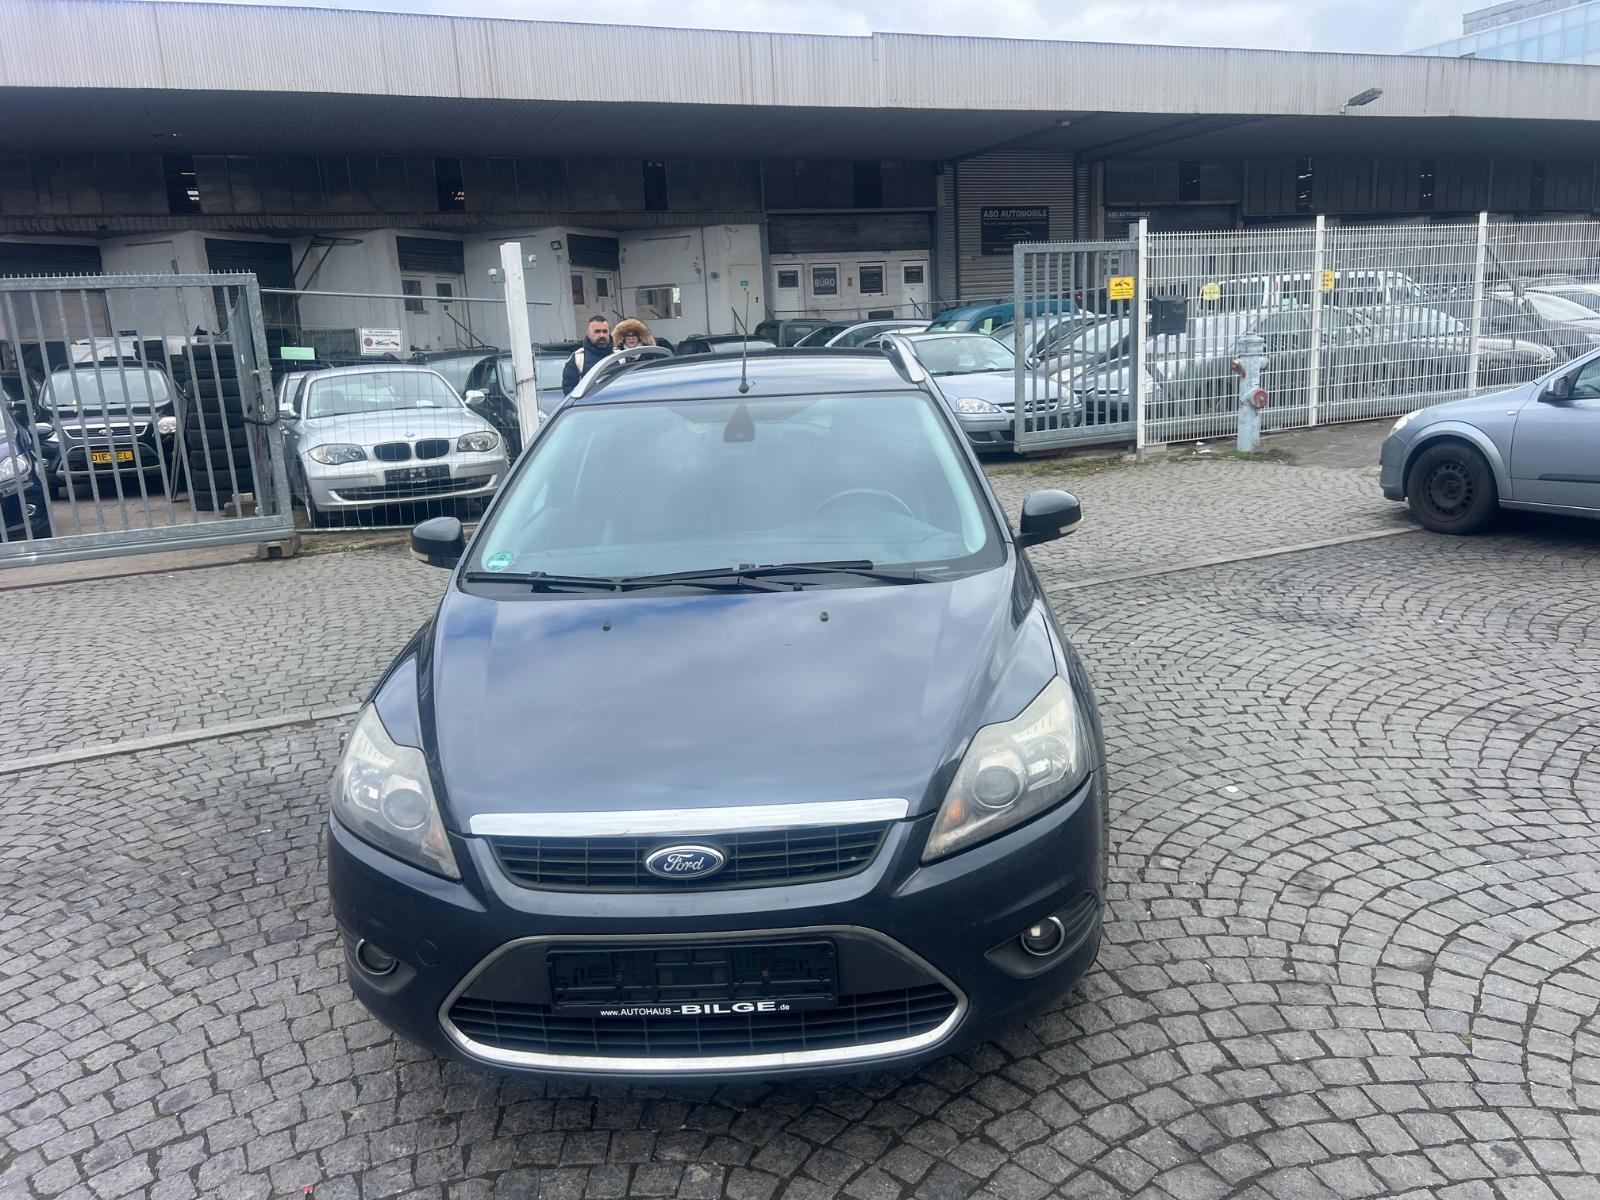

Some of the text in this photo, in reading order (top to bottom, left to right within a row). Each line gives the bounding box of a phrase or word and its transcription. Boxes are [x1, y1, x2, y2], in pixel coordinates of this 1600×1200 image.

[983, 210, 1047, 218] ASO AUTOMOBILE
[814, 277, 836, 288] BÜRO
[663, 853, 704, 872] Ford
